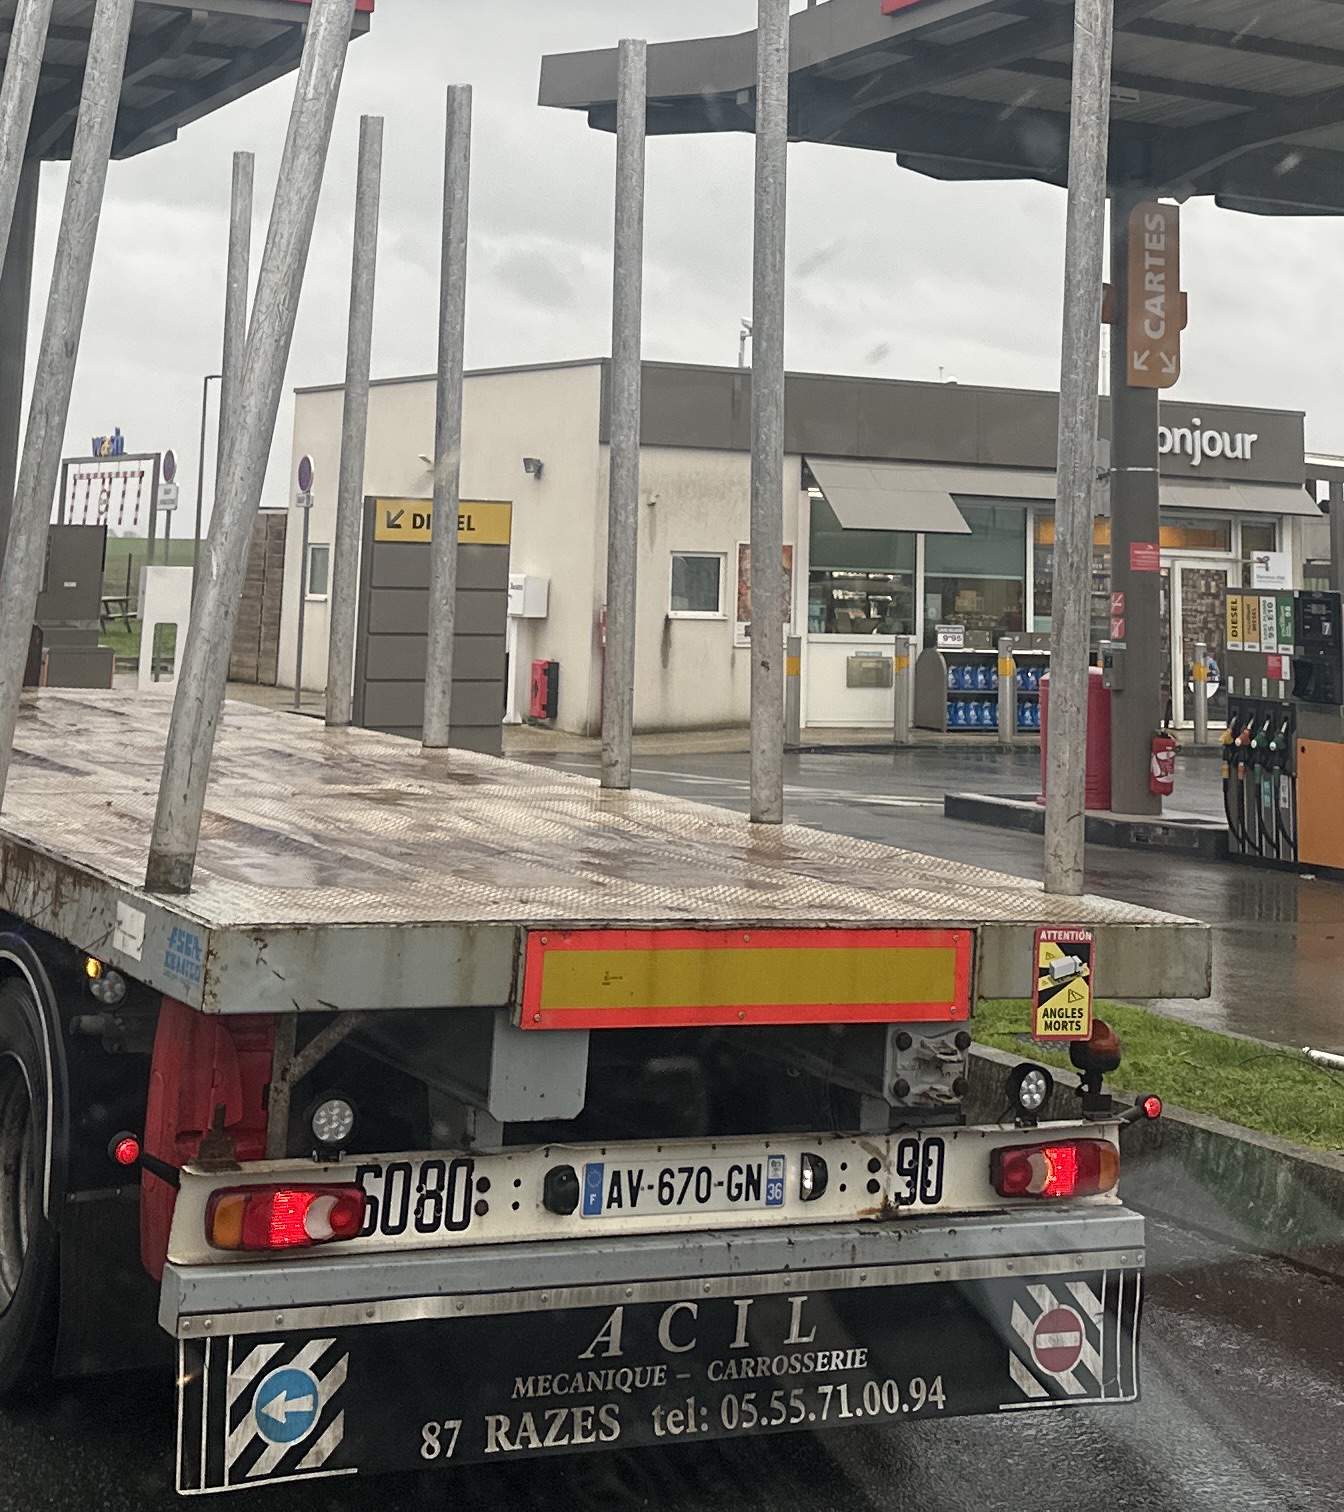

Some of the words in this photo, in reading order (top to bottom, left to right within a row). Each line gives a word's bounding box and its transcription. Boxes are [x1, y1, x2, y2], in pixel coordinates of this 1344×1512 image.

[1144, 213, 1165, 340] CARTES
[1158, 417, 1258, 467] onjour
[412, 512, 476, 532] DIEL
[1040, 929, 1092, 941] ATTENTION
[1042, 1007, 1084, 1019] ANGLES
[1044, 1020, 1082, 1032] MORTS
[589, 1193, 597, 1206] F
[606, 1163, 762, 1209] AV-670-GN
[767, 1182, 783, 1201] 36
[894, 1137, 945, 1206] 90
[510, 1364, 668, 1400] MECANIQUE
[707, 1348, 869, 1383] CARROSSERIE
[420, 1419, 463, 1460] 87
[483, 1403, 622, 1454] RAZES
[651, 1396, 709, 1438] tel:
[721, 1375, 947, 1431] 05.55.71.00.94
